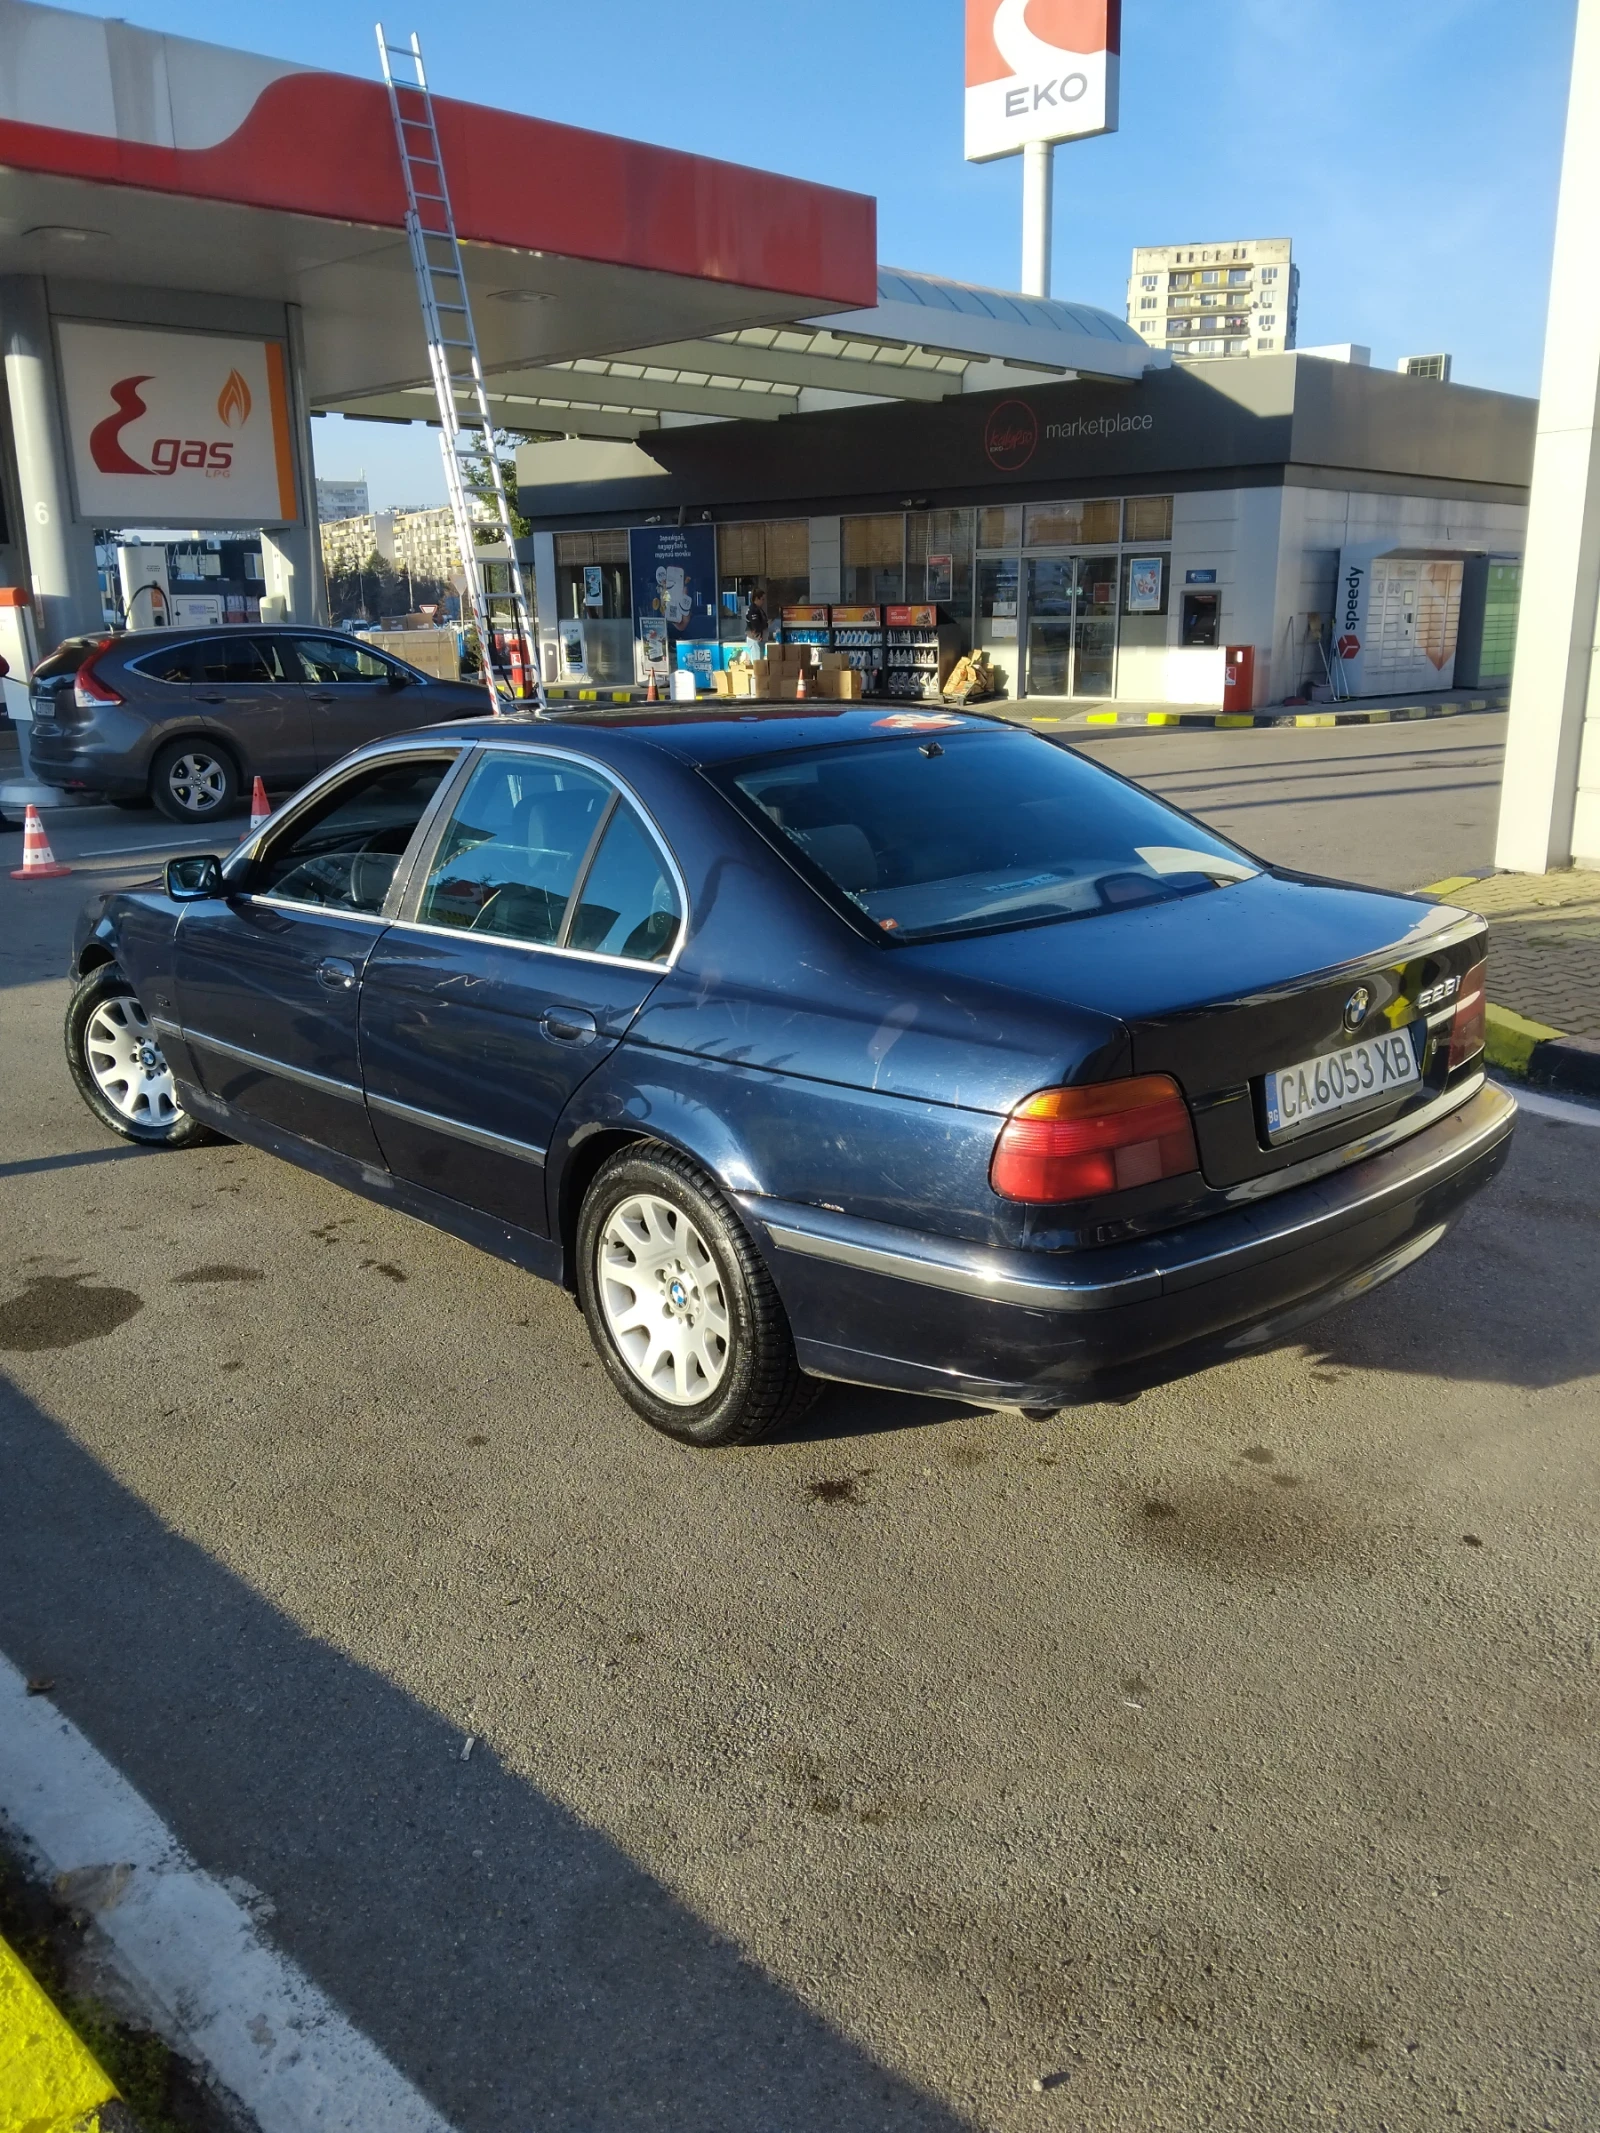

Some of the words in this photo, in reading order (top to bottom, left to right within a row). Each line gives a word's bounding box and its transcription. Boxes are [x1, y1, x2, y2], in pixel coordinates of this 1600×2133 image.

[1005, 72, 1088, 118] EKO
[990, 425, 1033, 448] kalypso
[1045, 412, 1153, 438] marketplace
[205, 469, 231, 478] LPG
[34, 501, 49, 525] 6
[1345, 566, 1364, 631] speedy
[694, 649, 712, 662] ICE
[1268, 1109, 1279, 1124] BG
